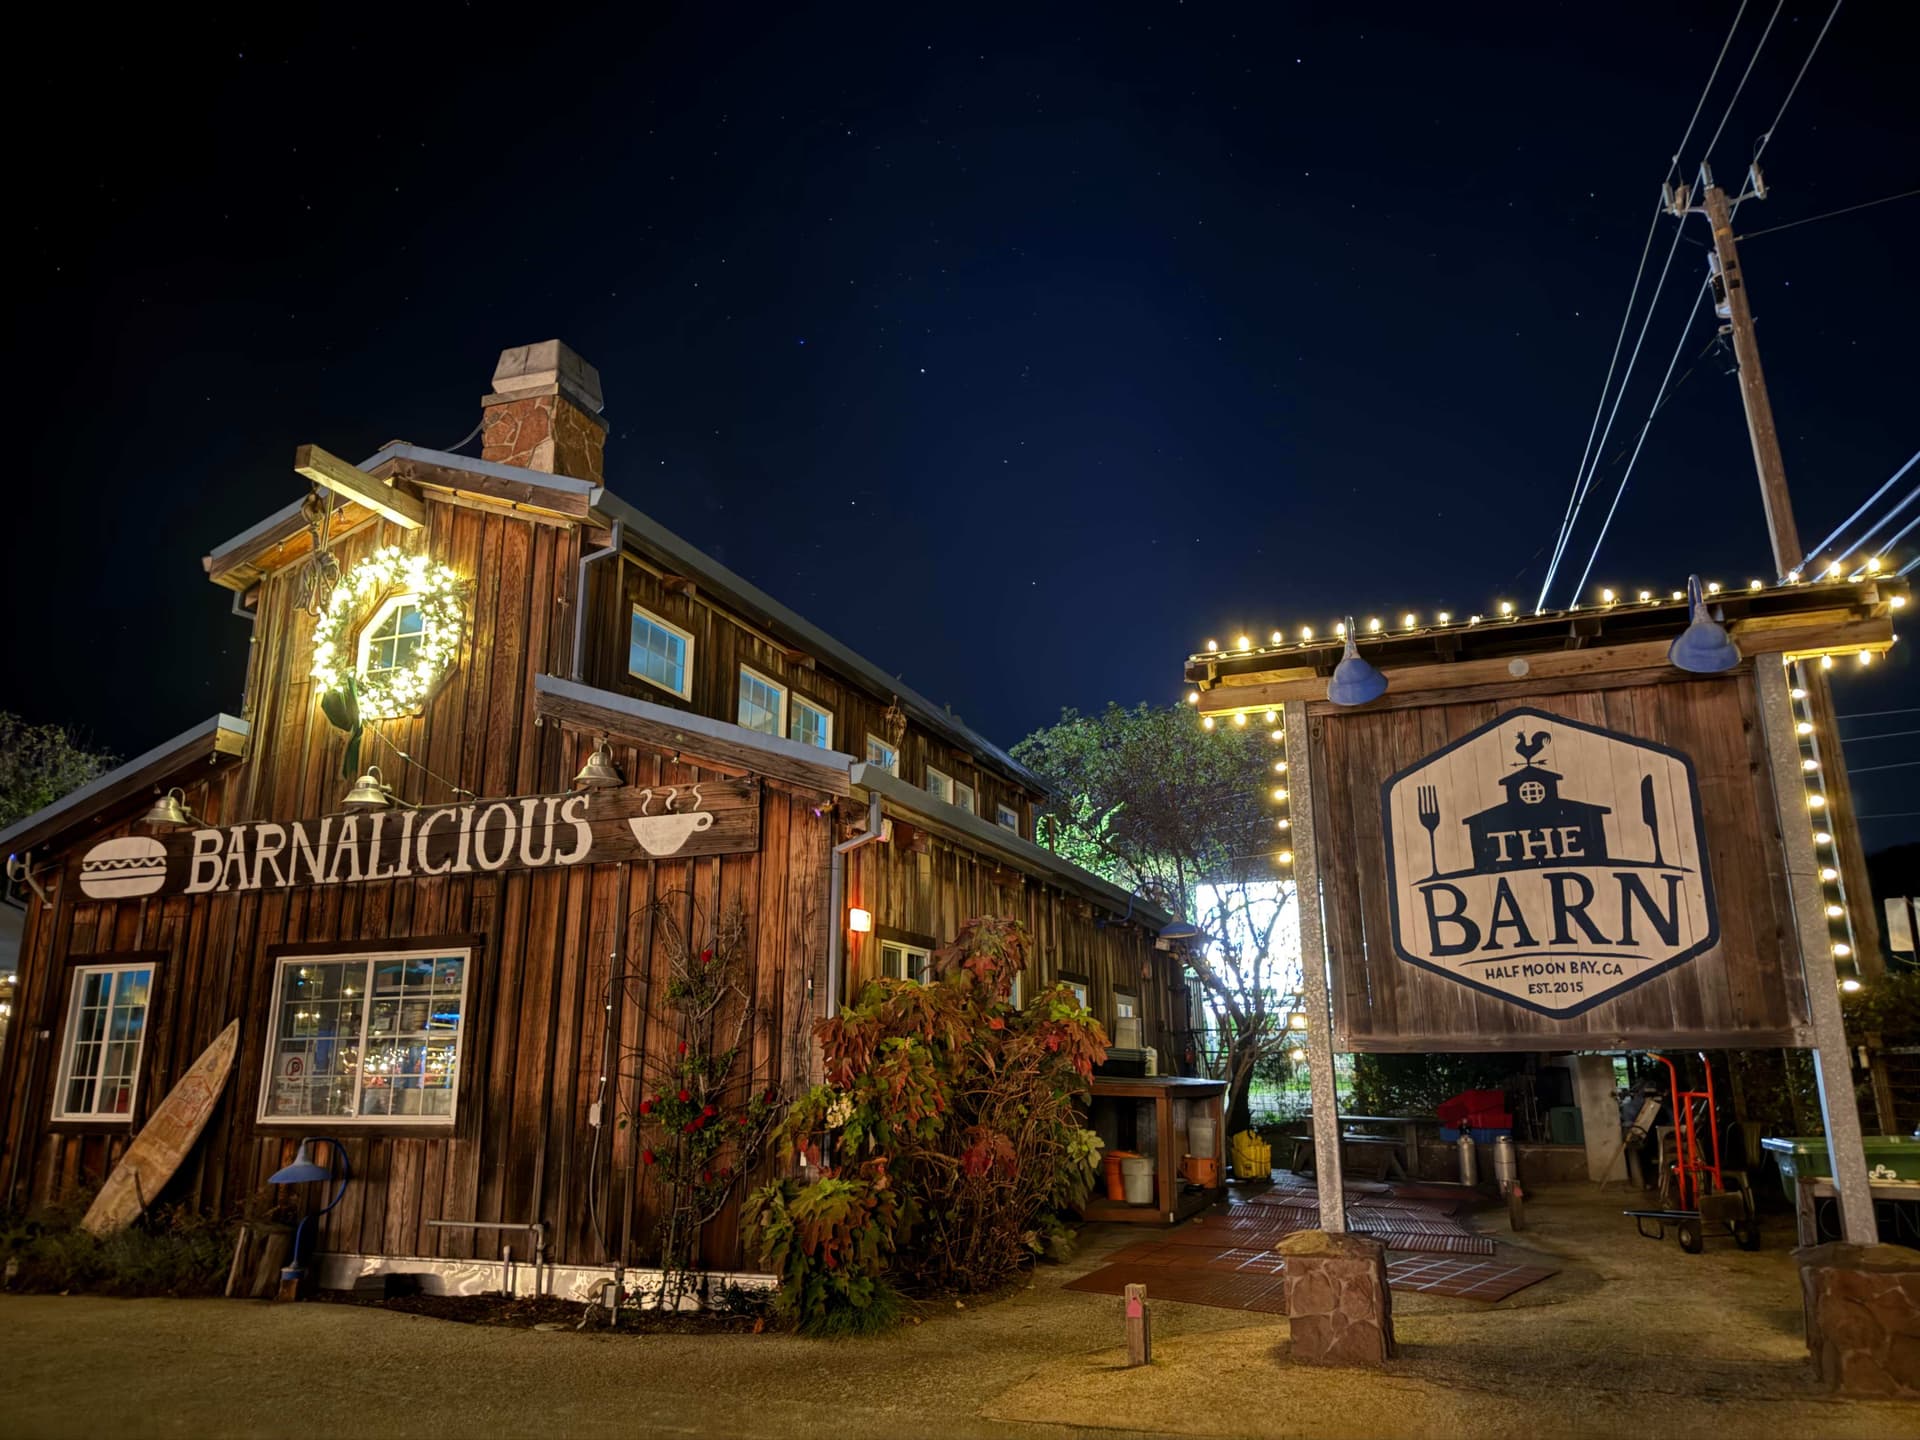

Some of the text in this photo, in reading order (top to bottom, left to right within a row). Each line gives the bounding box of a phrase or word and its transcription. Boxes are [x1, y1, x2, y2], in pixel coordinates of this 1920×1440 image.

[185, 795, 593, 894] BARNALICIOUS
[1488, 826, 1585, 862] THE
[1419, 872, 1684, 956] BARN
[1485, 961, 1623, 980] HALF MOON BAY, CA
[1528, 981, 1583, 994] EST. 2015
